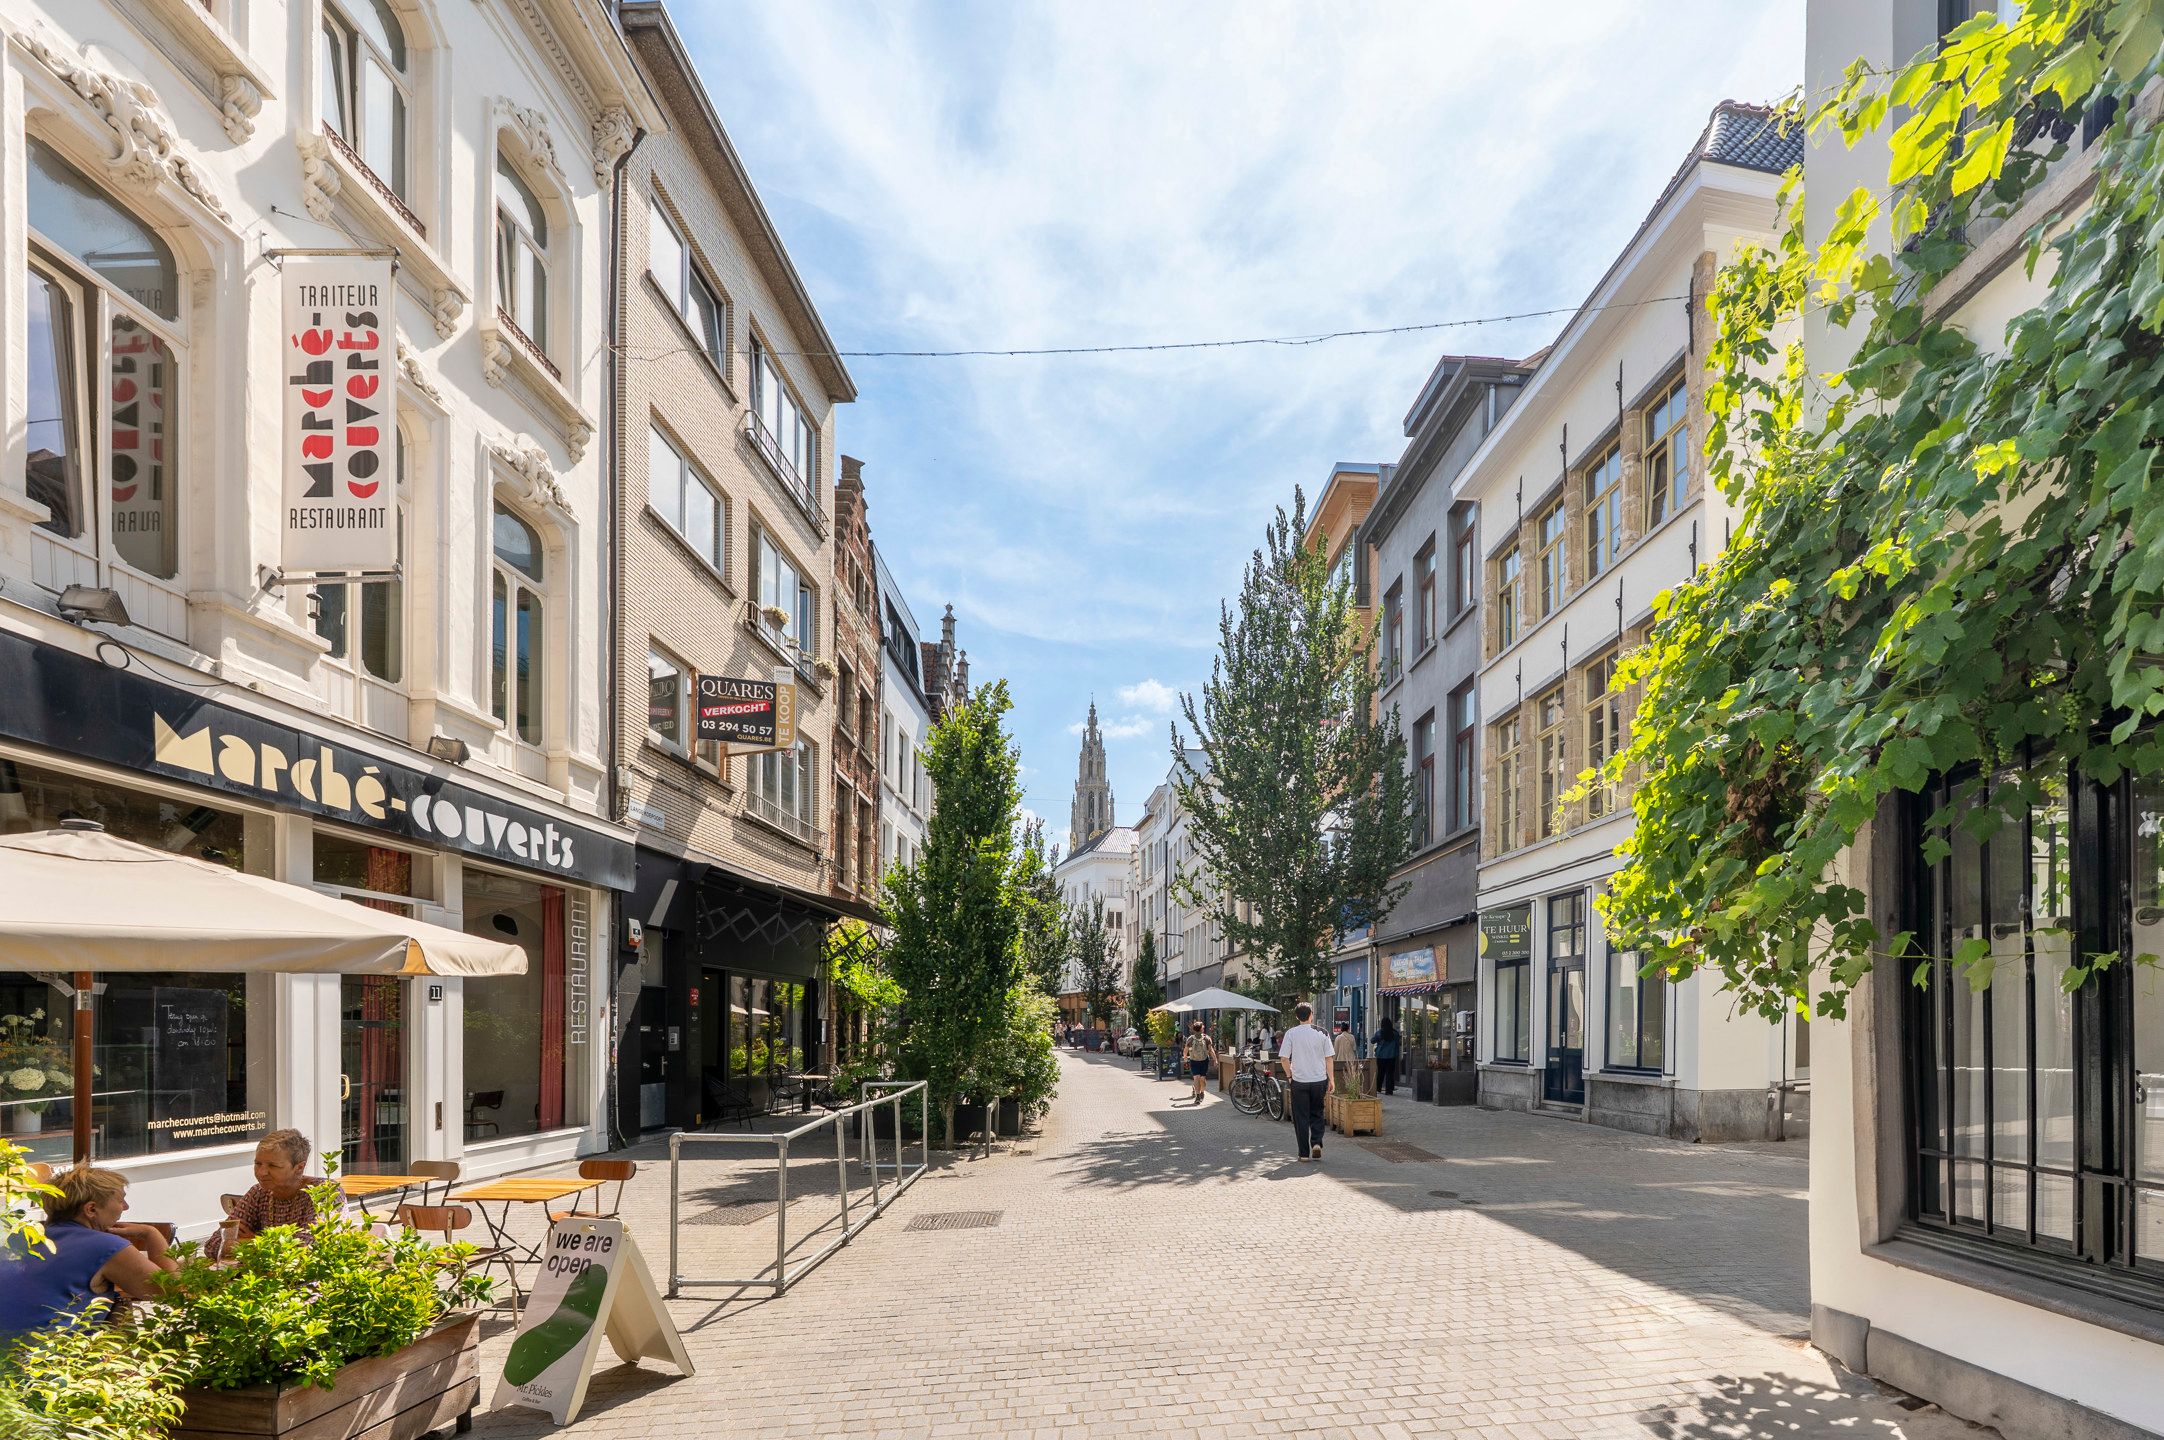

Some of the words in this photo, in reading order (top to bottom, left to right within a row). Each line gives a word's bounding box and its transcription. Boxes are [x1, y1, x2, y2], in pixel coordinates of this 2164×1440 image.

[299, 284, 378, 307] TRAITEUR
[289, 507, 386, 530] RESTAURANT
[700, 679, 774, 701] QUARES
[703, 702, 766, 717] VERKOCHT
[778, 686, 791, 725] KOOP
[701, 720, 716, 730] 03
[718, 722, 739, 732] 294
[742, 724, 756, 734] 50
[759, 727, 773, 736] 57
[778, 728, 790, 743] TE
[736, 734, 773, 743] QUARES.BE
[1483, 926, 1497, 934] TE
[1498, 925, 1527, 934] HUUR
[570, 895, 587, 1045] RESTAURANT
[430, 986, 442, 1000] 11
[147, 1110, 266, 1130] marchecouverts@hotmail.com
[172, 1121, 266, 1139] www.marchecouverts.be
[556, 1232, 582, 1251] we
[584, 1234, 613, 1254] are
[547, 1254, 592, 1279] open
[529, 1384, 553, 1399] Pickles
